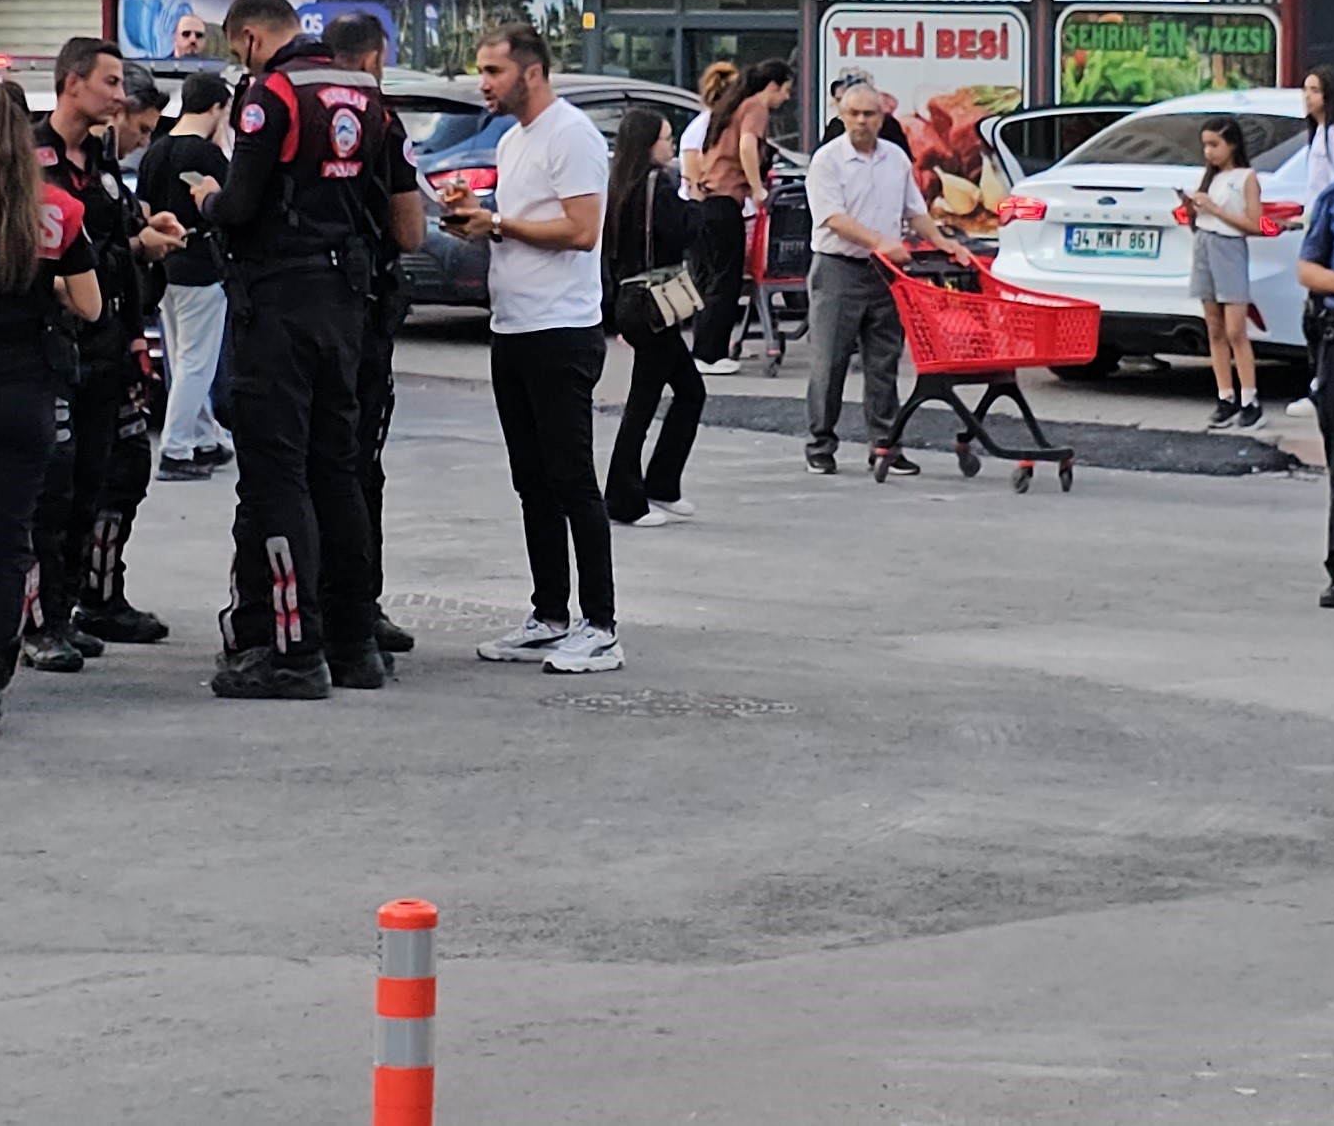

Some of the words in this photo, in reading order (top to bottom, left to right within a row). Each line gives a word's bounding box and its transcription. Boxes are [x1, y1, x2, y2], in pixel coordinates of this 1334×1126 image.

[832, 21, 925, 58] YERLİ
[935, 22, 1009, 60] BESİ
[1146, 21, 1188, 58] EN
[1074, 229, 1090, 248] 34
[1129, 231, 1155, 250] 861
